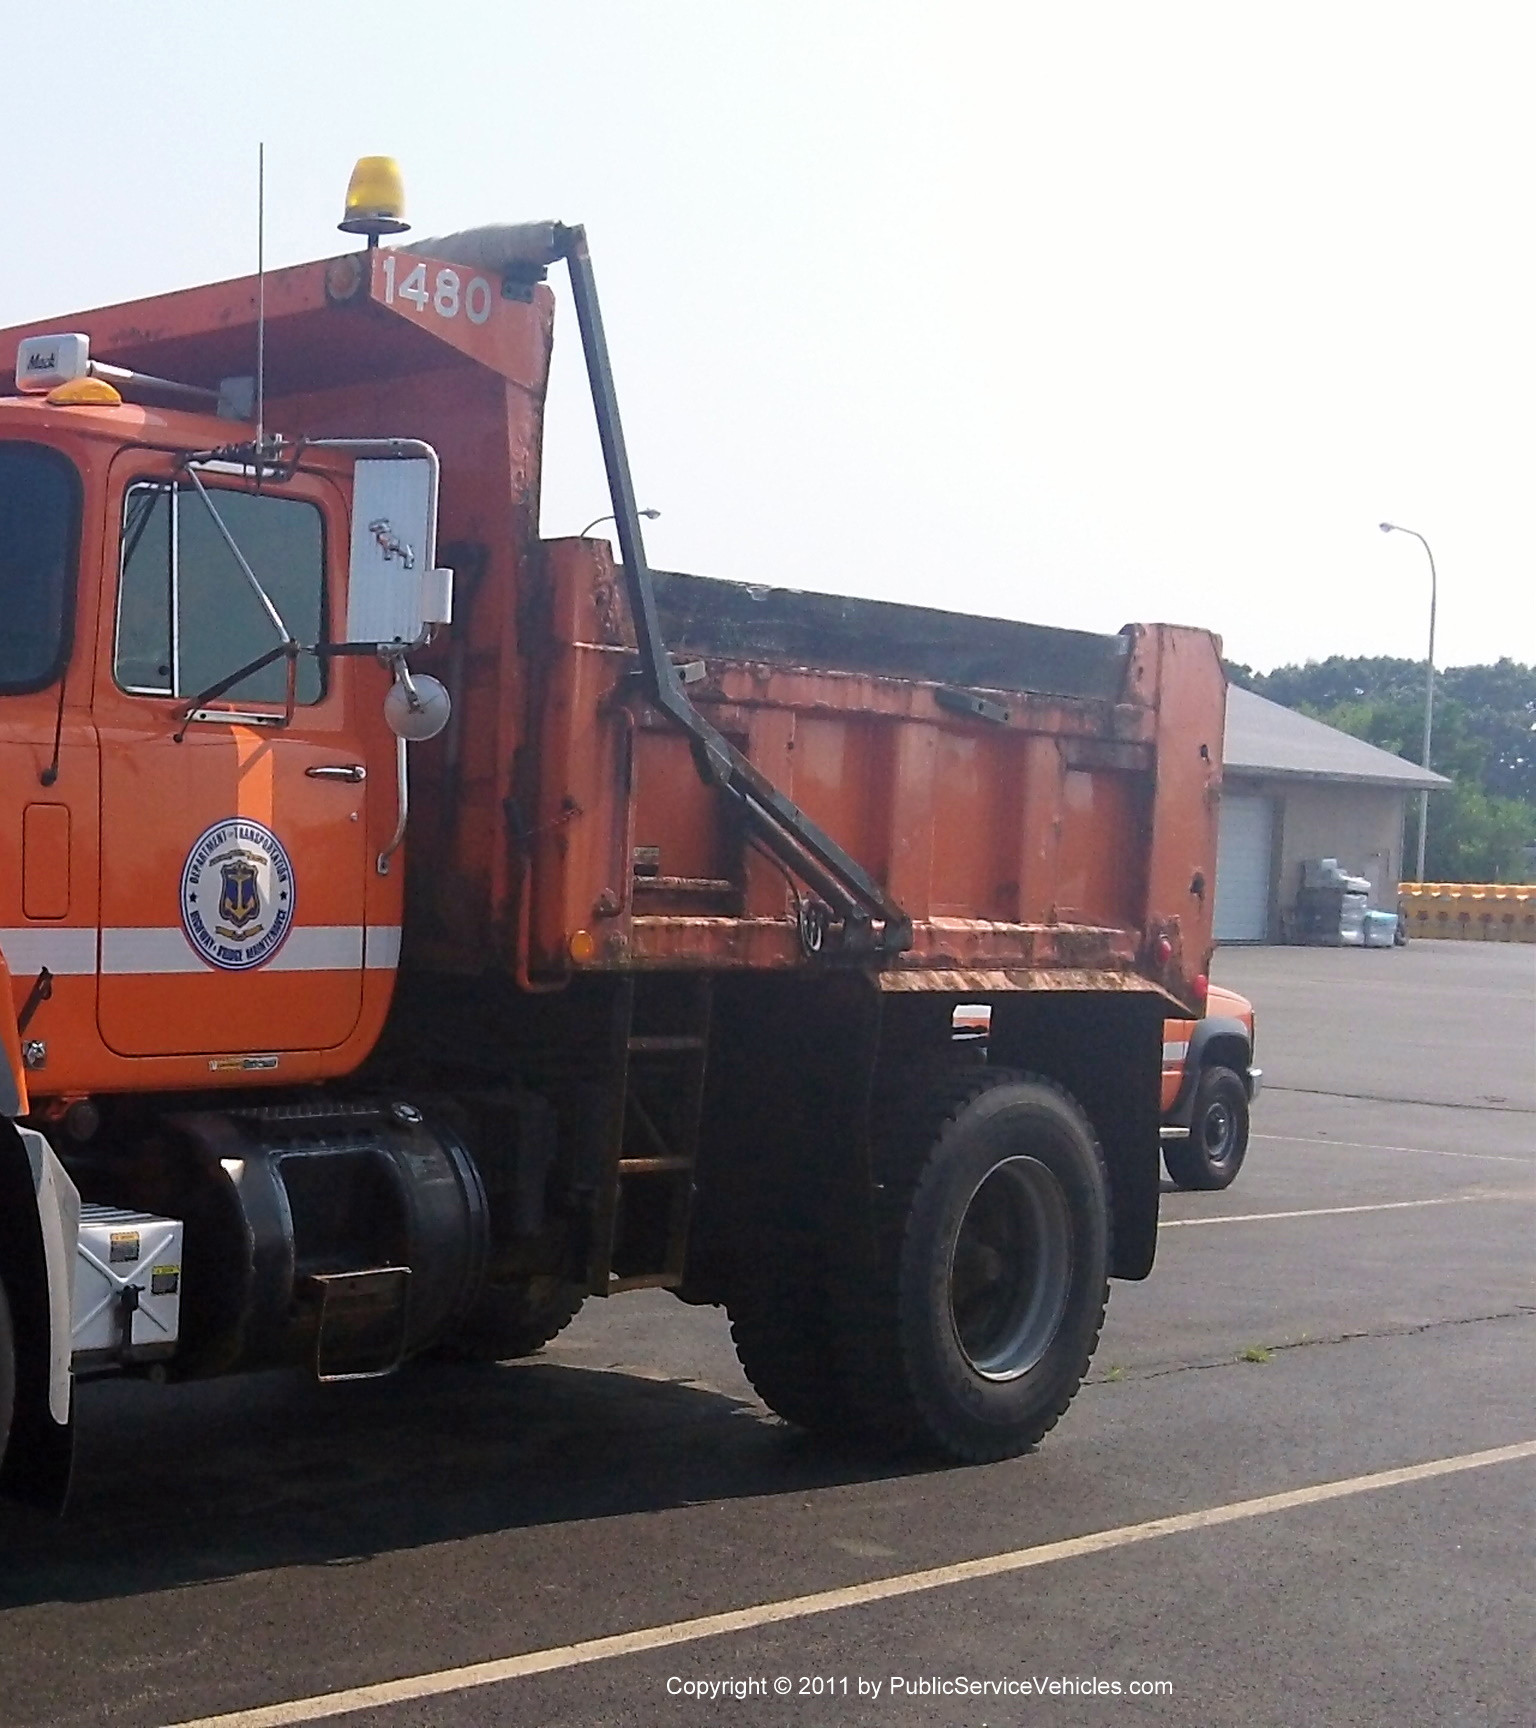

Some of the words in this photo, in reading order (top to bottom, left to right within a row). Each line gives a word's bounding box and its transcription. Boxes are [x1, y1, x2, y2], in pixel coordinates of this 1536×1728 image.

[382, 256, 492, 325] 1480
[27, 352, 55, 370] Mack
[189, 830, 227, 884] DEPARTMENT
[234, 827, 287, 883] TRANSPORTATION
